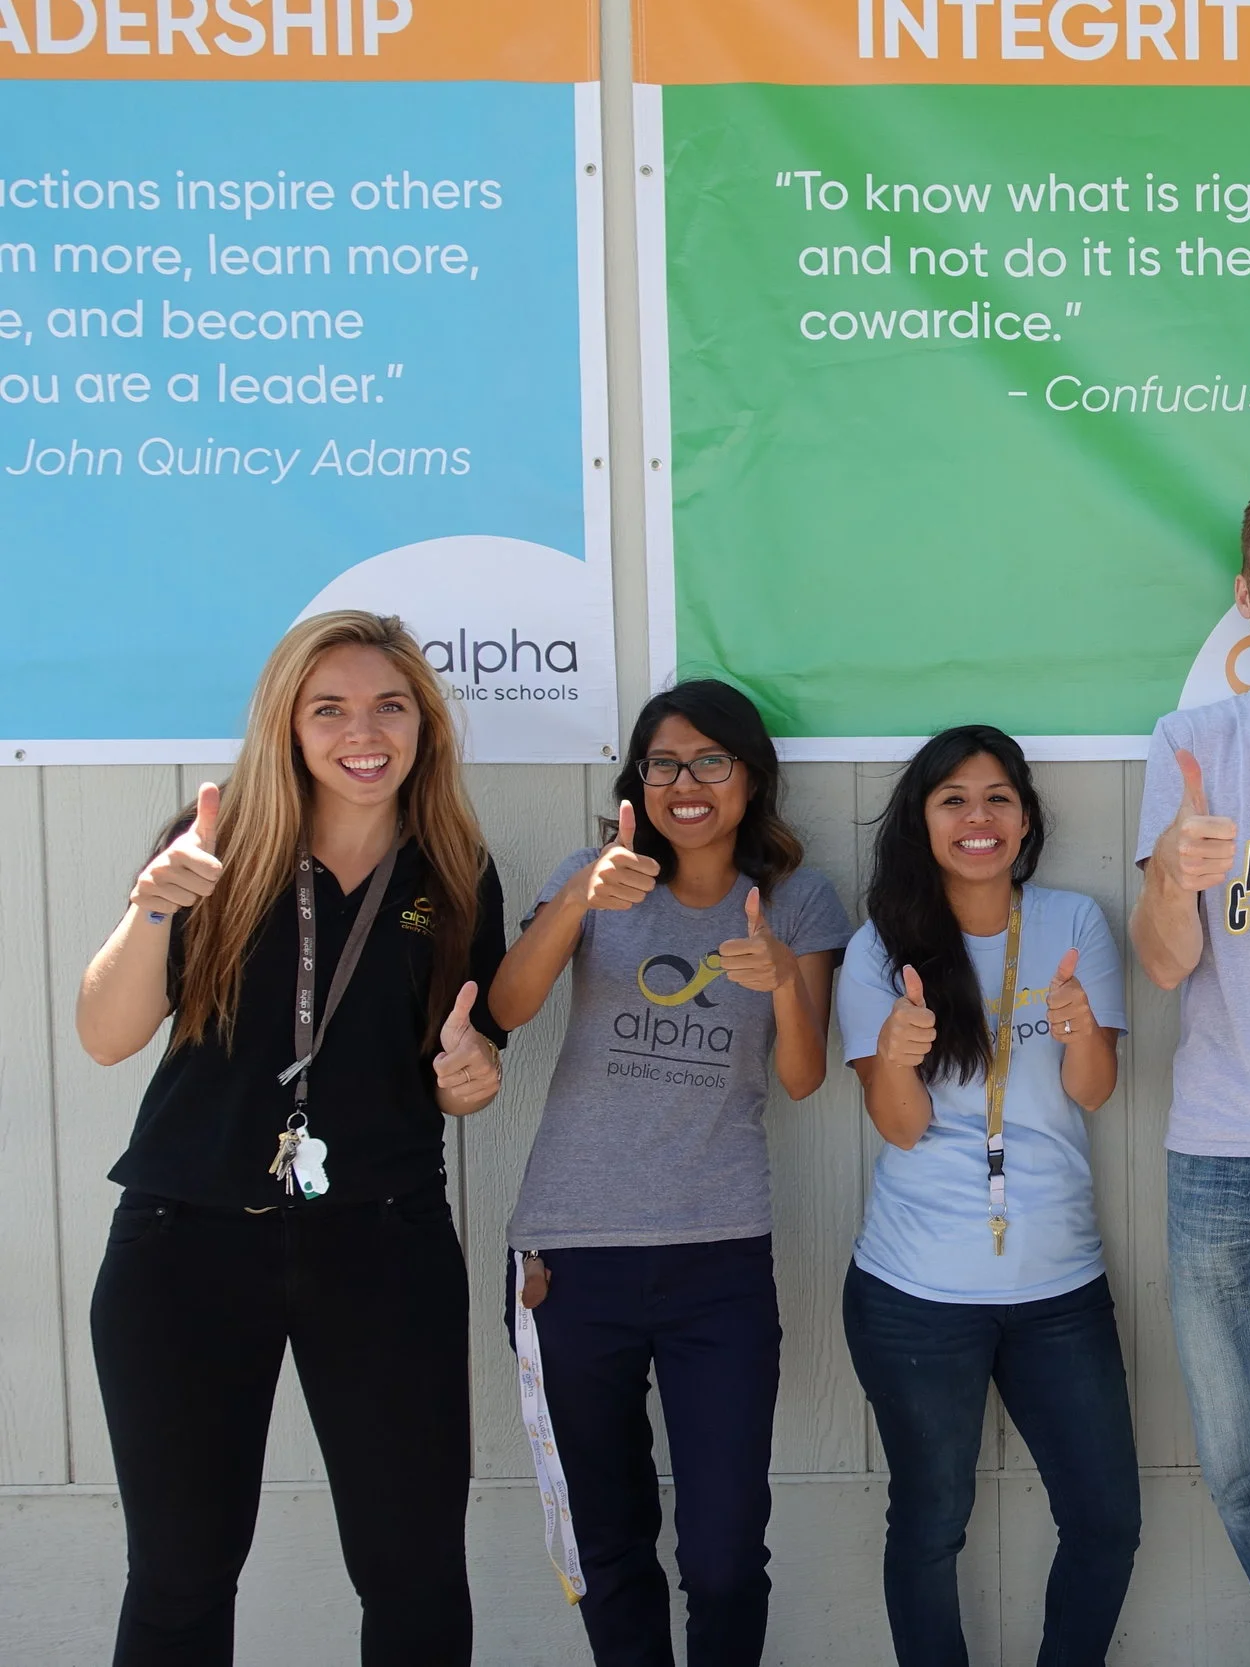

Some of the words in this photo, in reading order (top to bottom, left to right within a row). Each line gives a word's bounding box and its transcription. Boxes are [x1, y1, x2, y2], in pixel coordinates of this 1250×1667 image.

[0, 170, 161, 210] ctions
[177, 170, 336, 220] inspire
[351, 171, 504, 211] others
[866, 174, 992, 214] know
[1008, 174, 1130, 213] what
[1146, 173, 1180, 213] is
[54, 244, 193, 282] more,
[209, 234, 331, 275] learn
[348, 244, 480, 281] more,
[799, 236, 892, 277] and
[909, 242, 989, 278] not
[1004, 238, 1068, 278] do
[1083, 237, 1113, 277] it
[1128, 237, 1162, 277] is
[47, 300, 144, 338] and
[162, 300, 365, 340] become
[75, 373, 151, 404] are
[167, 373, 200, 403] a
[6, 439, 124, 477] John
[137, 437, 301, 485] Quincy
[310, 440, 472, 477] Adams
[421, 627, 578, 685] alpha
[494, 684, 579, 701] schools
[613, 1007, 734, 1053] alpha
[607, 1060, 661, 1081] public
[664, 1069, 727, 1089] schools
